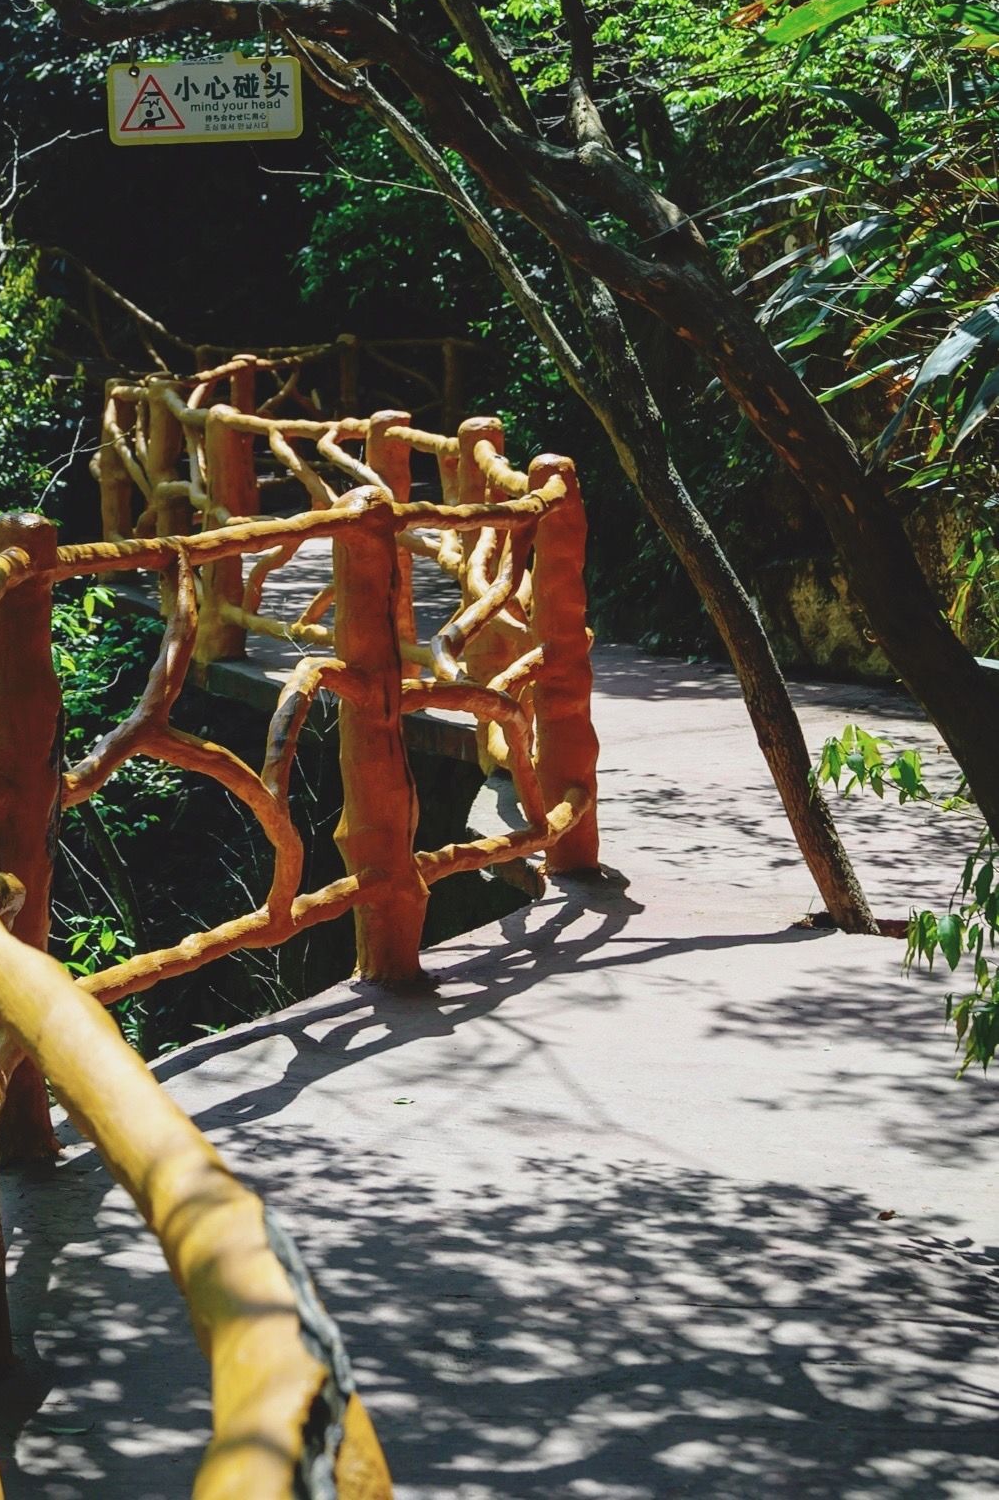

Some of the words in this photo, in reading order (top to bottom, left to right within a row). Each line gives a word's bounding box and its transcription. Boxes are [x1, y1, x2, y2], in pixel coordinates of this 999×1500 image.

[174, 72, 290, 102] 小心碰头
[190, 101, 219, 112] mind
[222, 101, 248, 113] your
[251, 99, 281, 109] head
